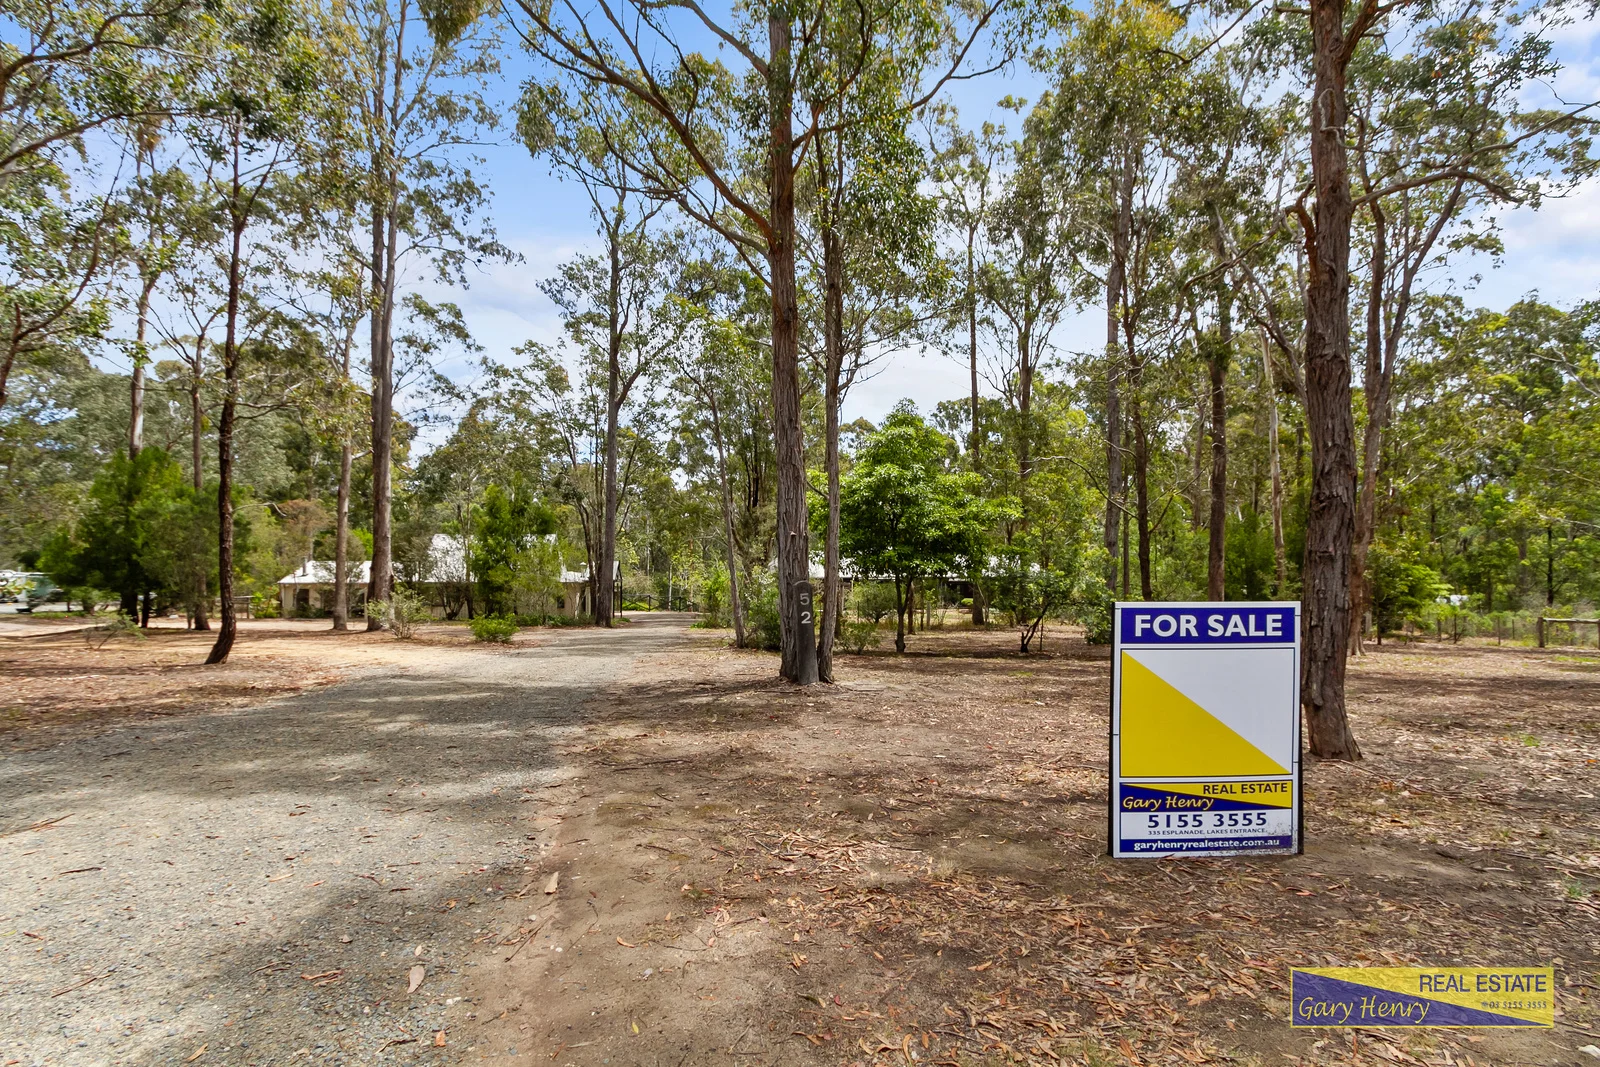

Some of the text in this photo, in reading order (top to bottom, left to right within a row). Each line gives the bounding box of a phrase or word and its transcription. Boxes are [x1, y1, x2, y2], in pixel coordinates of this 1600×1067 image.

[800, 593, 810, 605] 5
[800, 611, 811, 624] 2
[1135, 614, 1282, 637] FOR SALE
[1203, 782, 1288, 795] REAL ESTATE
[1122, 795, 1214, 811] Gary Henry
[1147, 812, 1267, 828] 5155 3555
[1134, 838, 1280, 851] garyhenryrealestate.com.au
